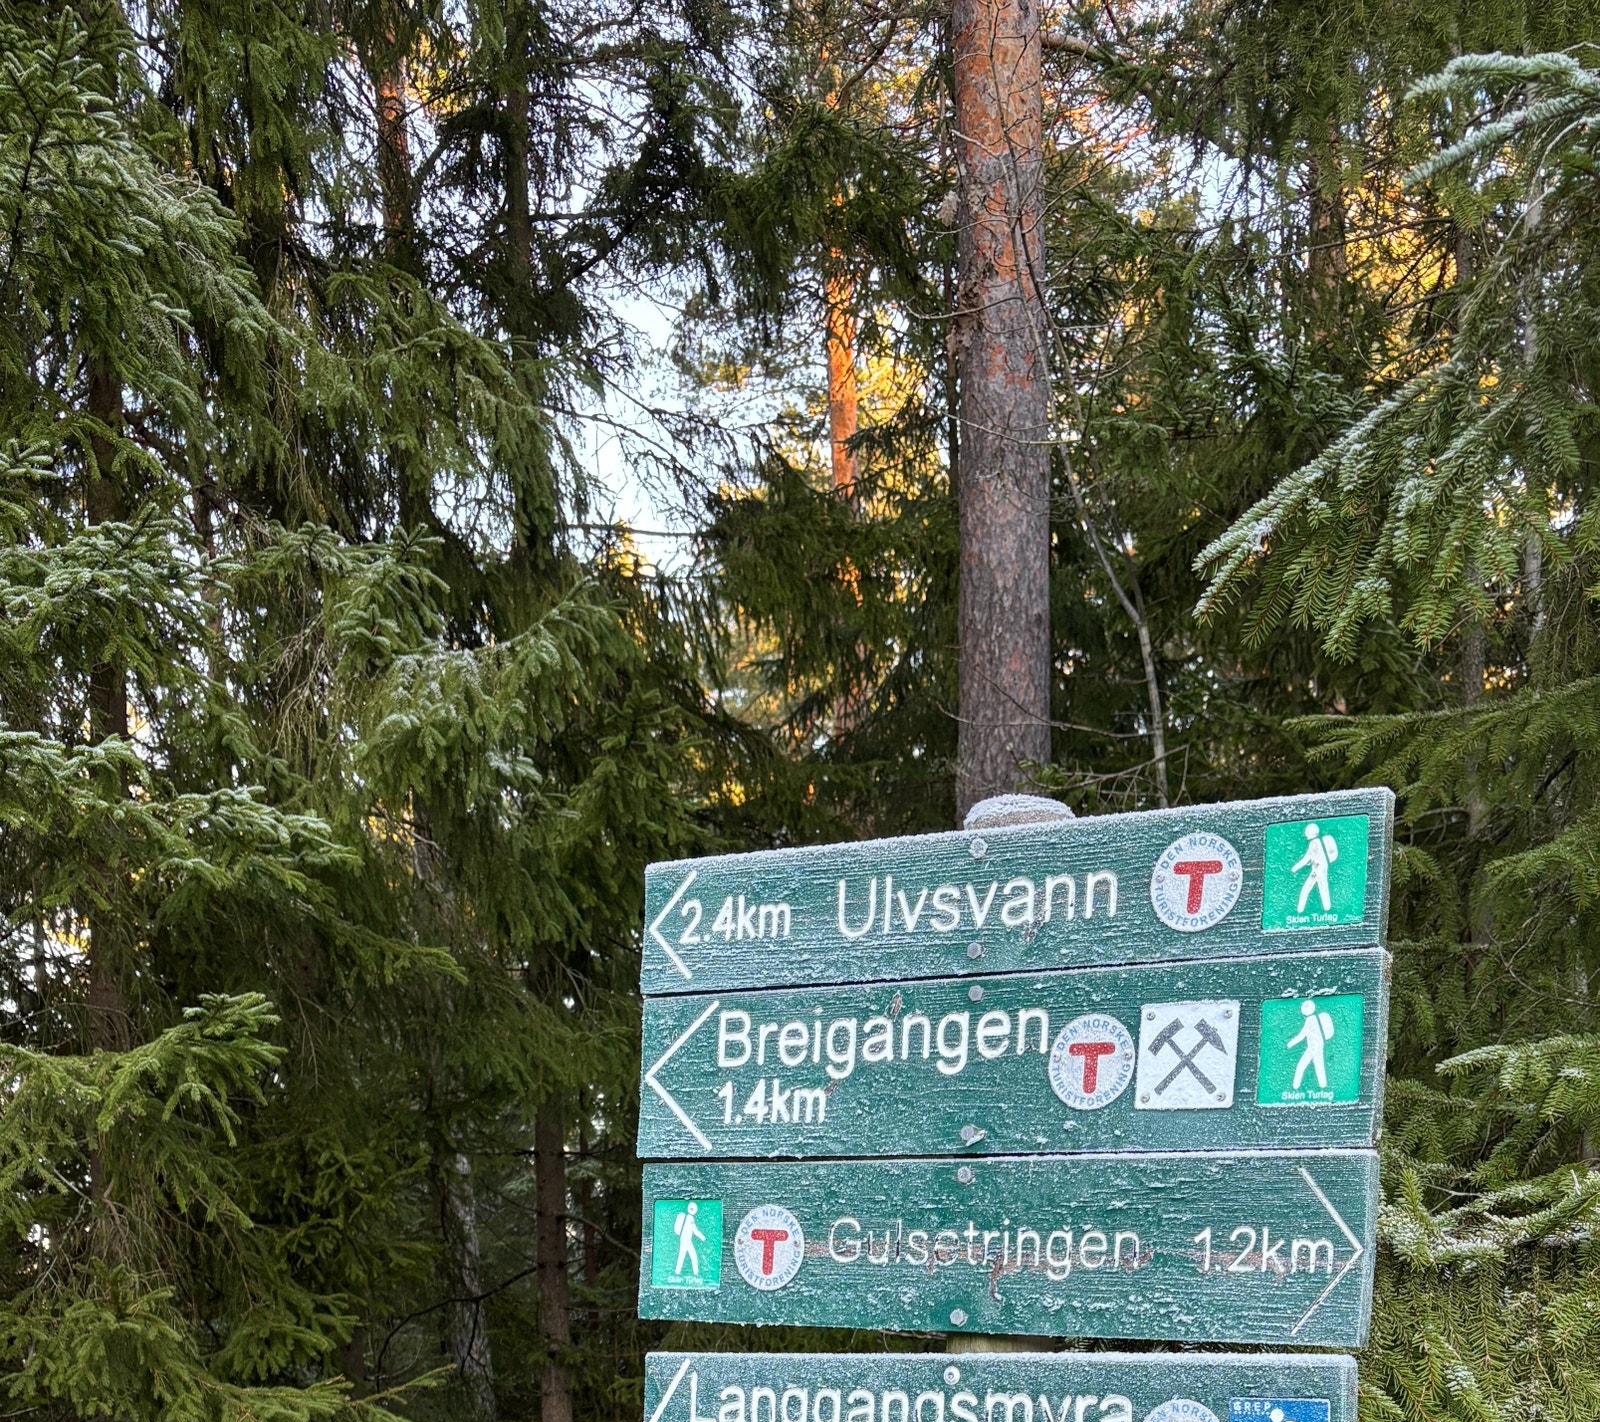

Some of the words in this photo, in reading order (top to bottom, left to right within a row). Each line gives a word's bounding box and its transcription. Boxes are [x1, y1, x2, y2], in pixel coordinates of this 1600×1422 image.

[1160, 844, 1183, 869] DEN
[1189, 837, 1237, 868] NORSKE
[680, 895, 791, 943] 2.4km
[838, 870, 1118, 938] Ulvsvann
[1155, 883, 1238, 927] TURISTFORENING
[1173, 861, 1223, 914] T
[717, 1008, 1050, 1080] Breigangen
[1057, 1026, 1078, 1051] DEN
[1083, 1019, 1129, 1049] NORSKE
[1052, 1064, 1130, 1107] TURISTFORENING
[1069, 1042, 1116, 1094] T
[717, 1079, 827, 1124] 1.4km
[751, 1229, 789, 1276] T
[829, 1217, 1140, 1281] Gulsetringen
[1194, 1226, 1334, 1274] 1.2km
[1233, 1401, 1271, 1411] GREP
